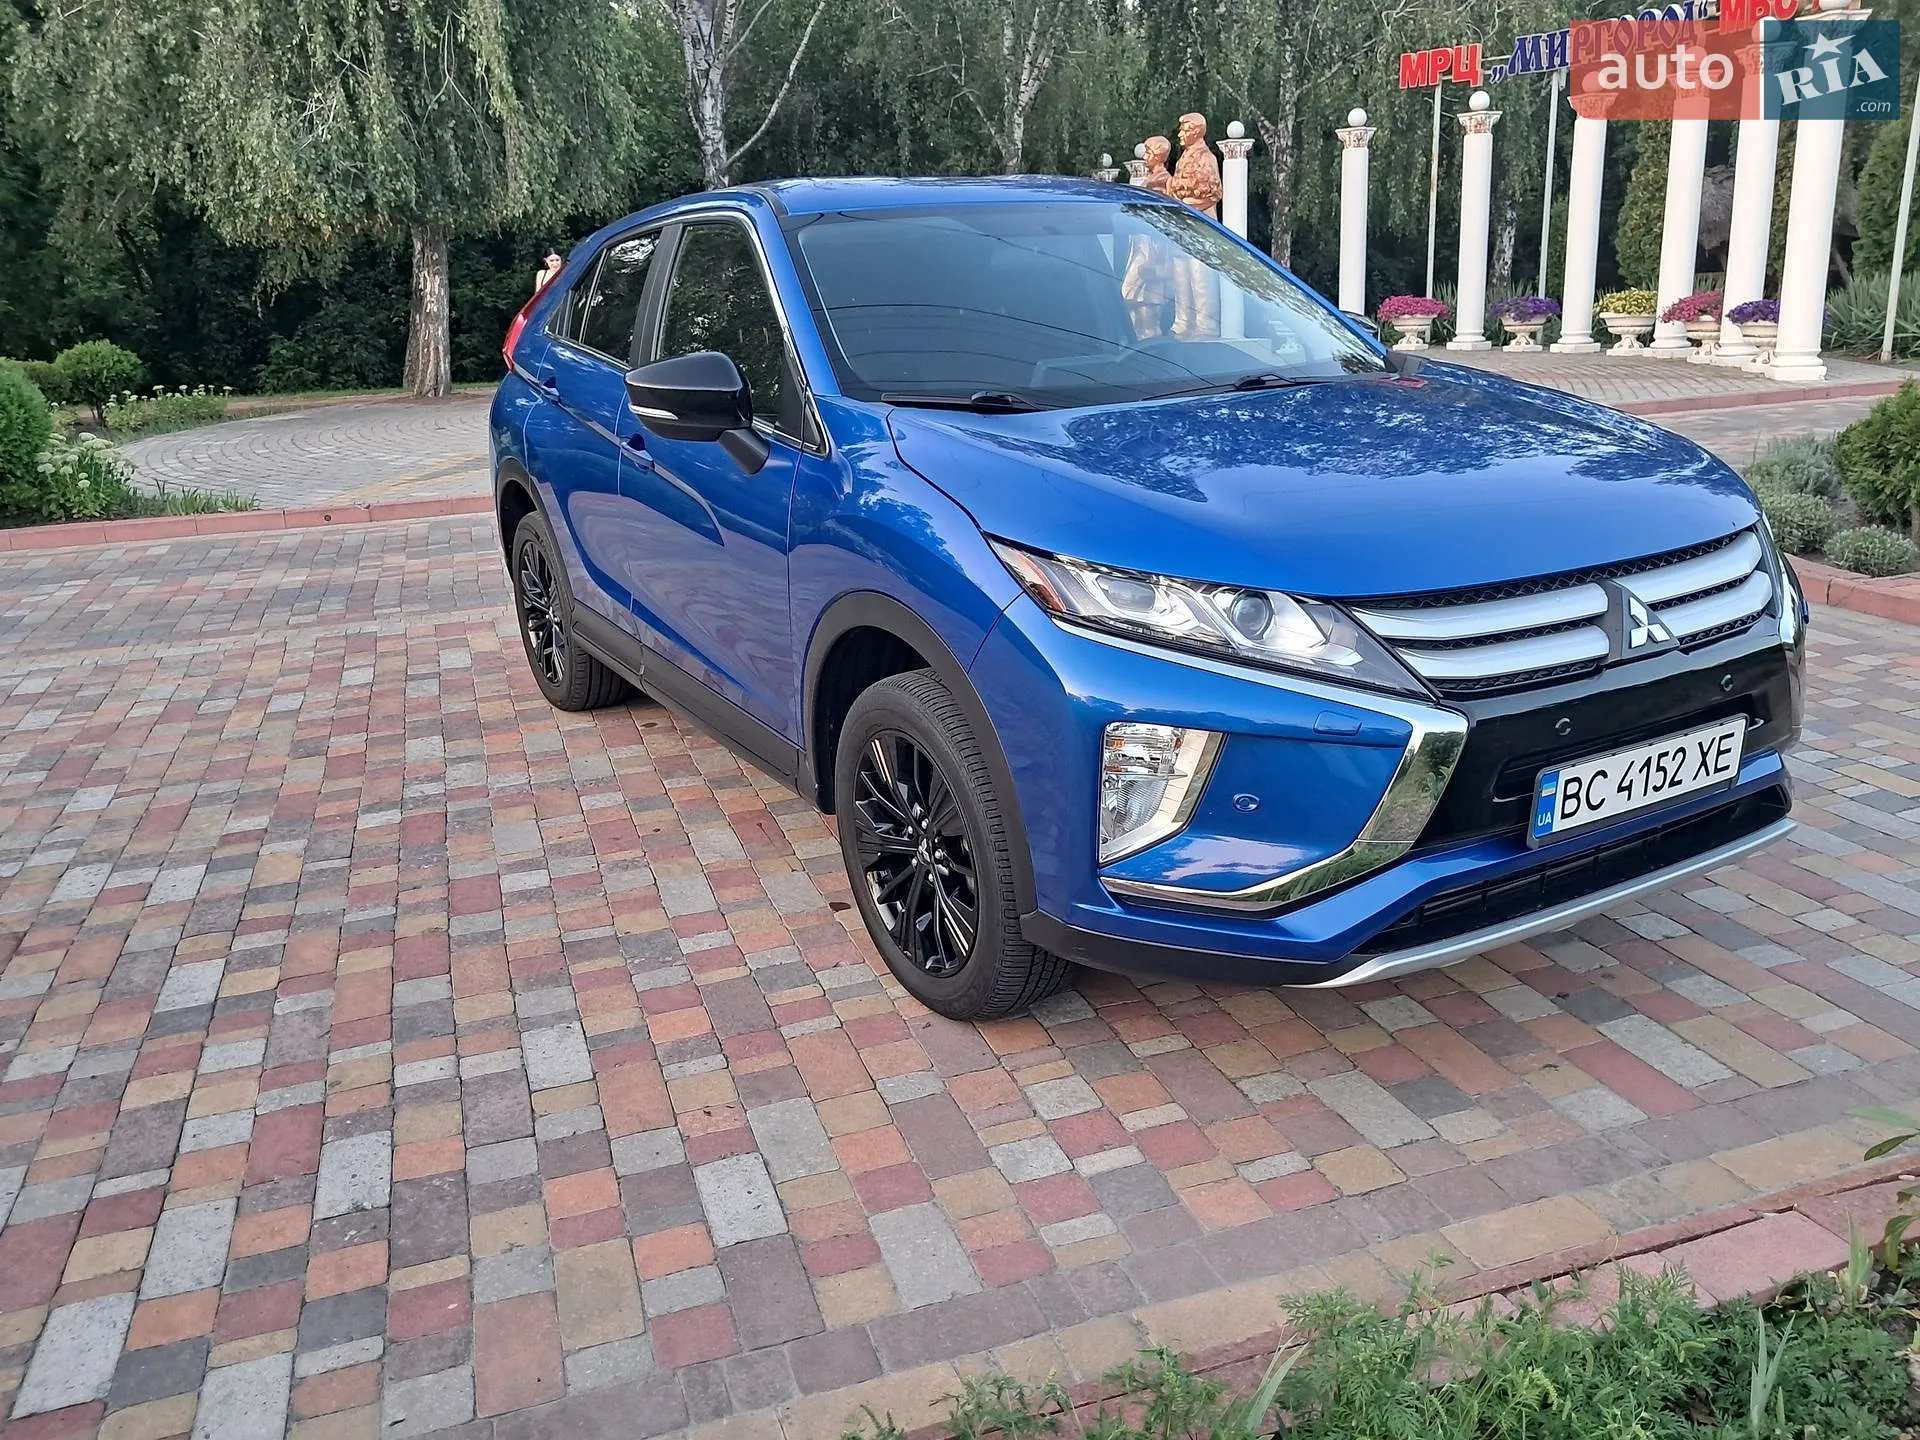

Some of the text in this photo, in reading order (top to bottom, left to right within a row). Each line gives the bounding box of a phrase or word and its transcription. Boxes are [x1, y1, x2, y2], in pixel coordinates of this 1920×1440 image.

[1399, 43, 1483, 89] МРЦ
[1560, 731, 1736, 820] BC 4152 XE
[1537, 813, 1552, 827] UA
